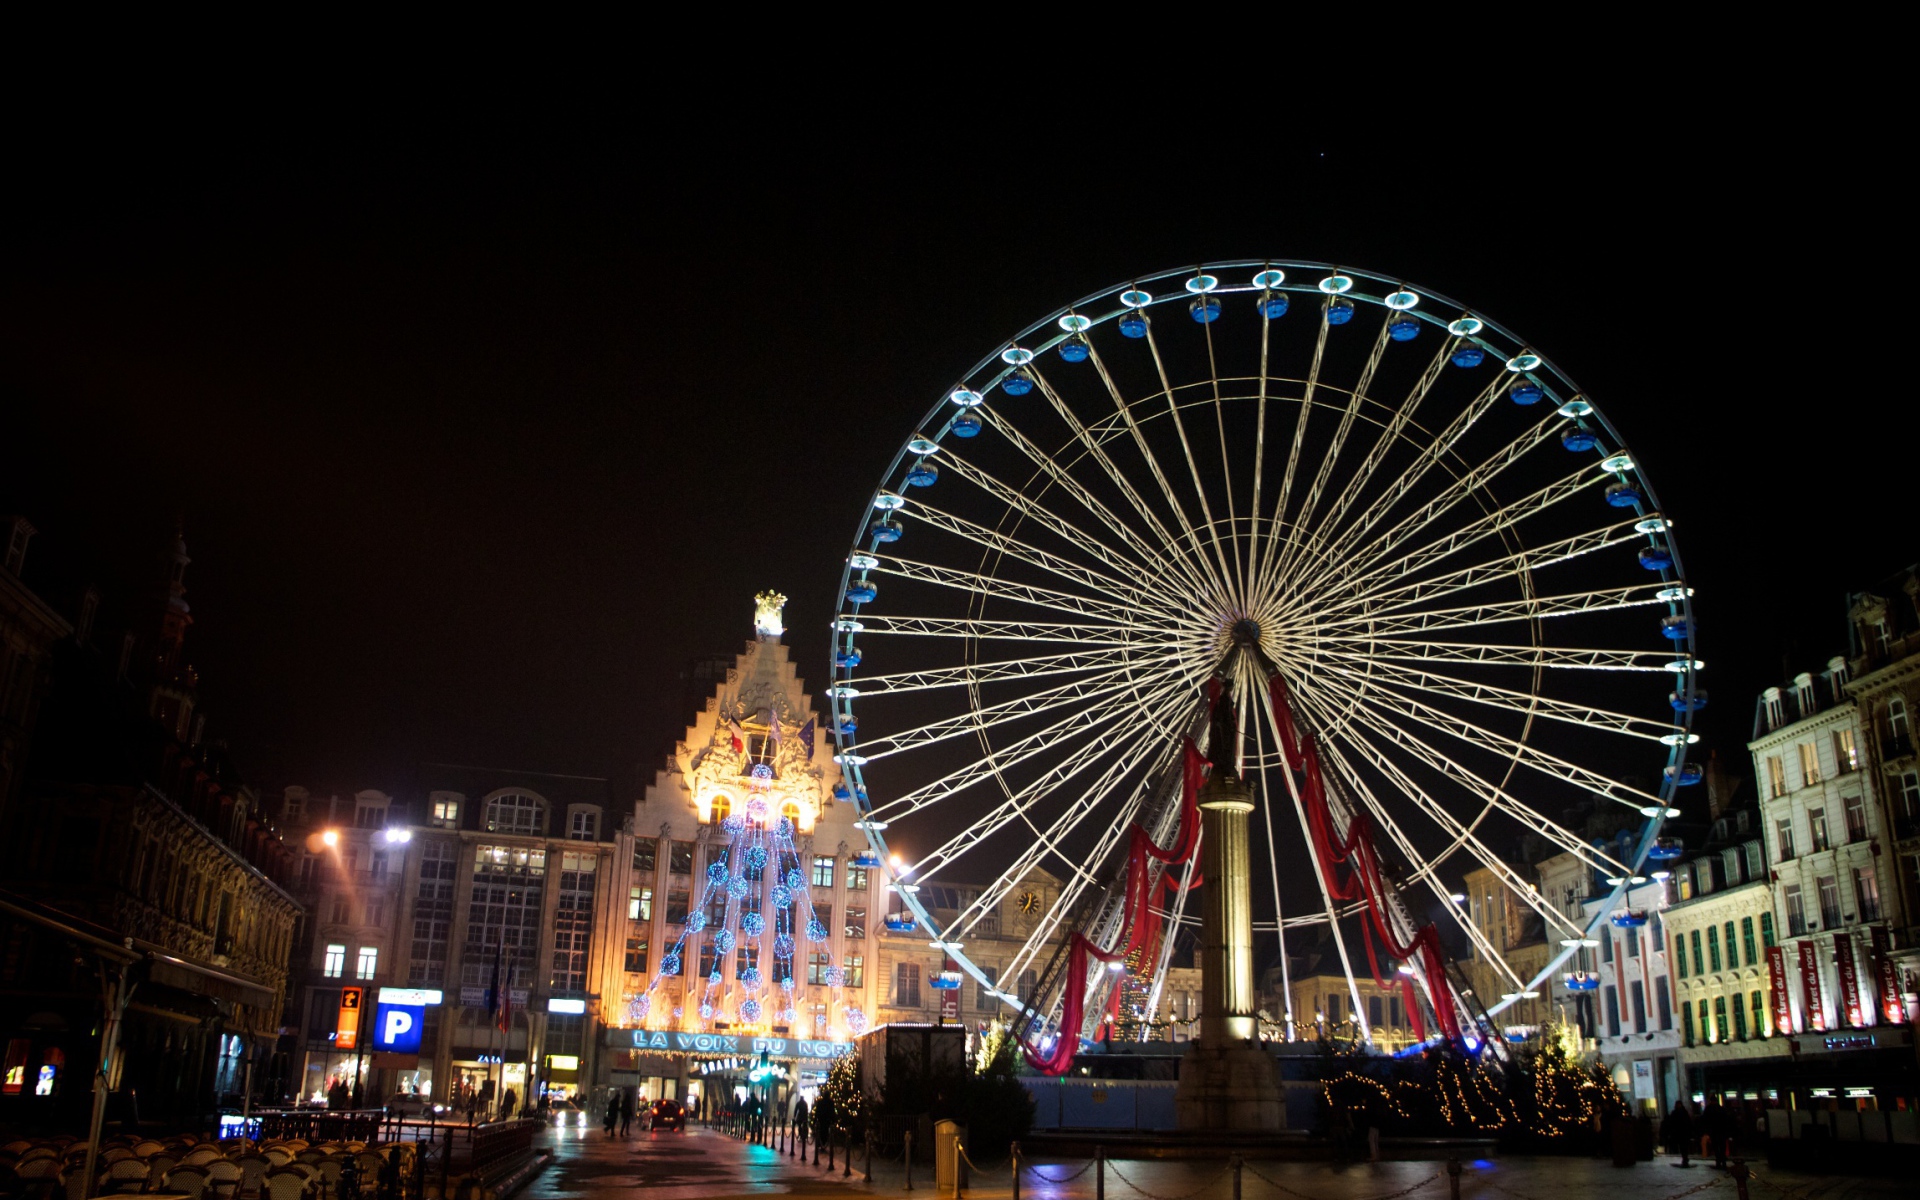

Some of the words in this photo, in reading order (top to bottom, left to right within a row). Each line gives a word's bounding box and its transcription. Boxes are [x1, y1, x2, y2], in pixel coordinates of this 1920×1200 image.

[1803, 947, 1814, 969] nord
[1841, 941, 1850, 963] nord
[1772, 953, 1783, 974] nord
[1844, 965, 1853, 979] du
[1882, 961, 1892, 974] du
[1775, 977, 1784, 990] du
[1808, 972, 1816, 985] du
[1885, 976, 1897, 1002] furet
[1777, 990, 1788, 1015] furet
[1810, 985, 1820, 1010] furet
[1847, 982, 1858, 1007] furet
[384, 1010, 413, 1044] P
[633, 1030, 668, 1048] LA
[677, 1033, 738, 1051] VOIX
[752, 1039, 786, 1054] DU
[798, 1041, 854, 1058] NOR
[477, 1054, 502, 1064] ZARA
